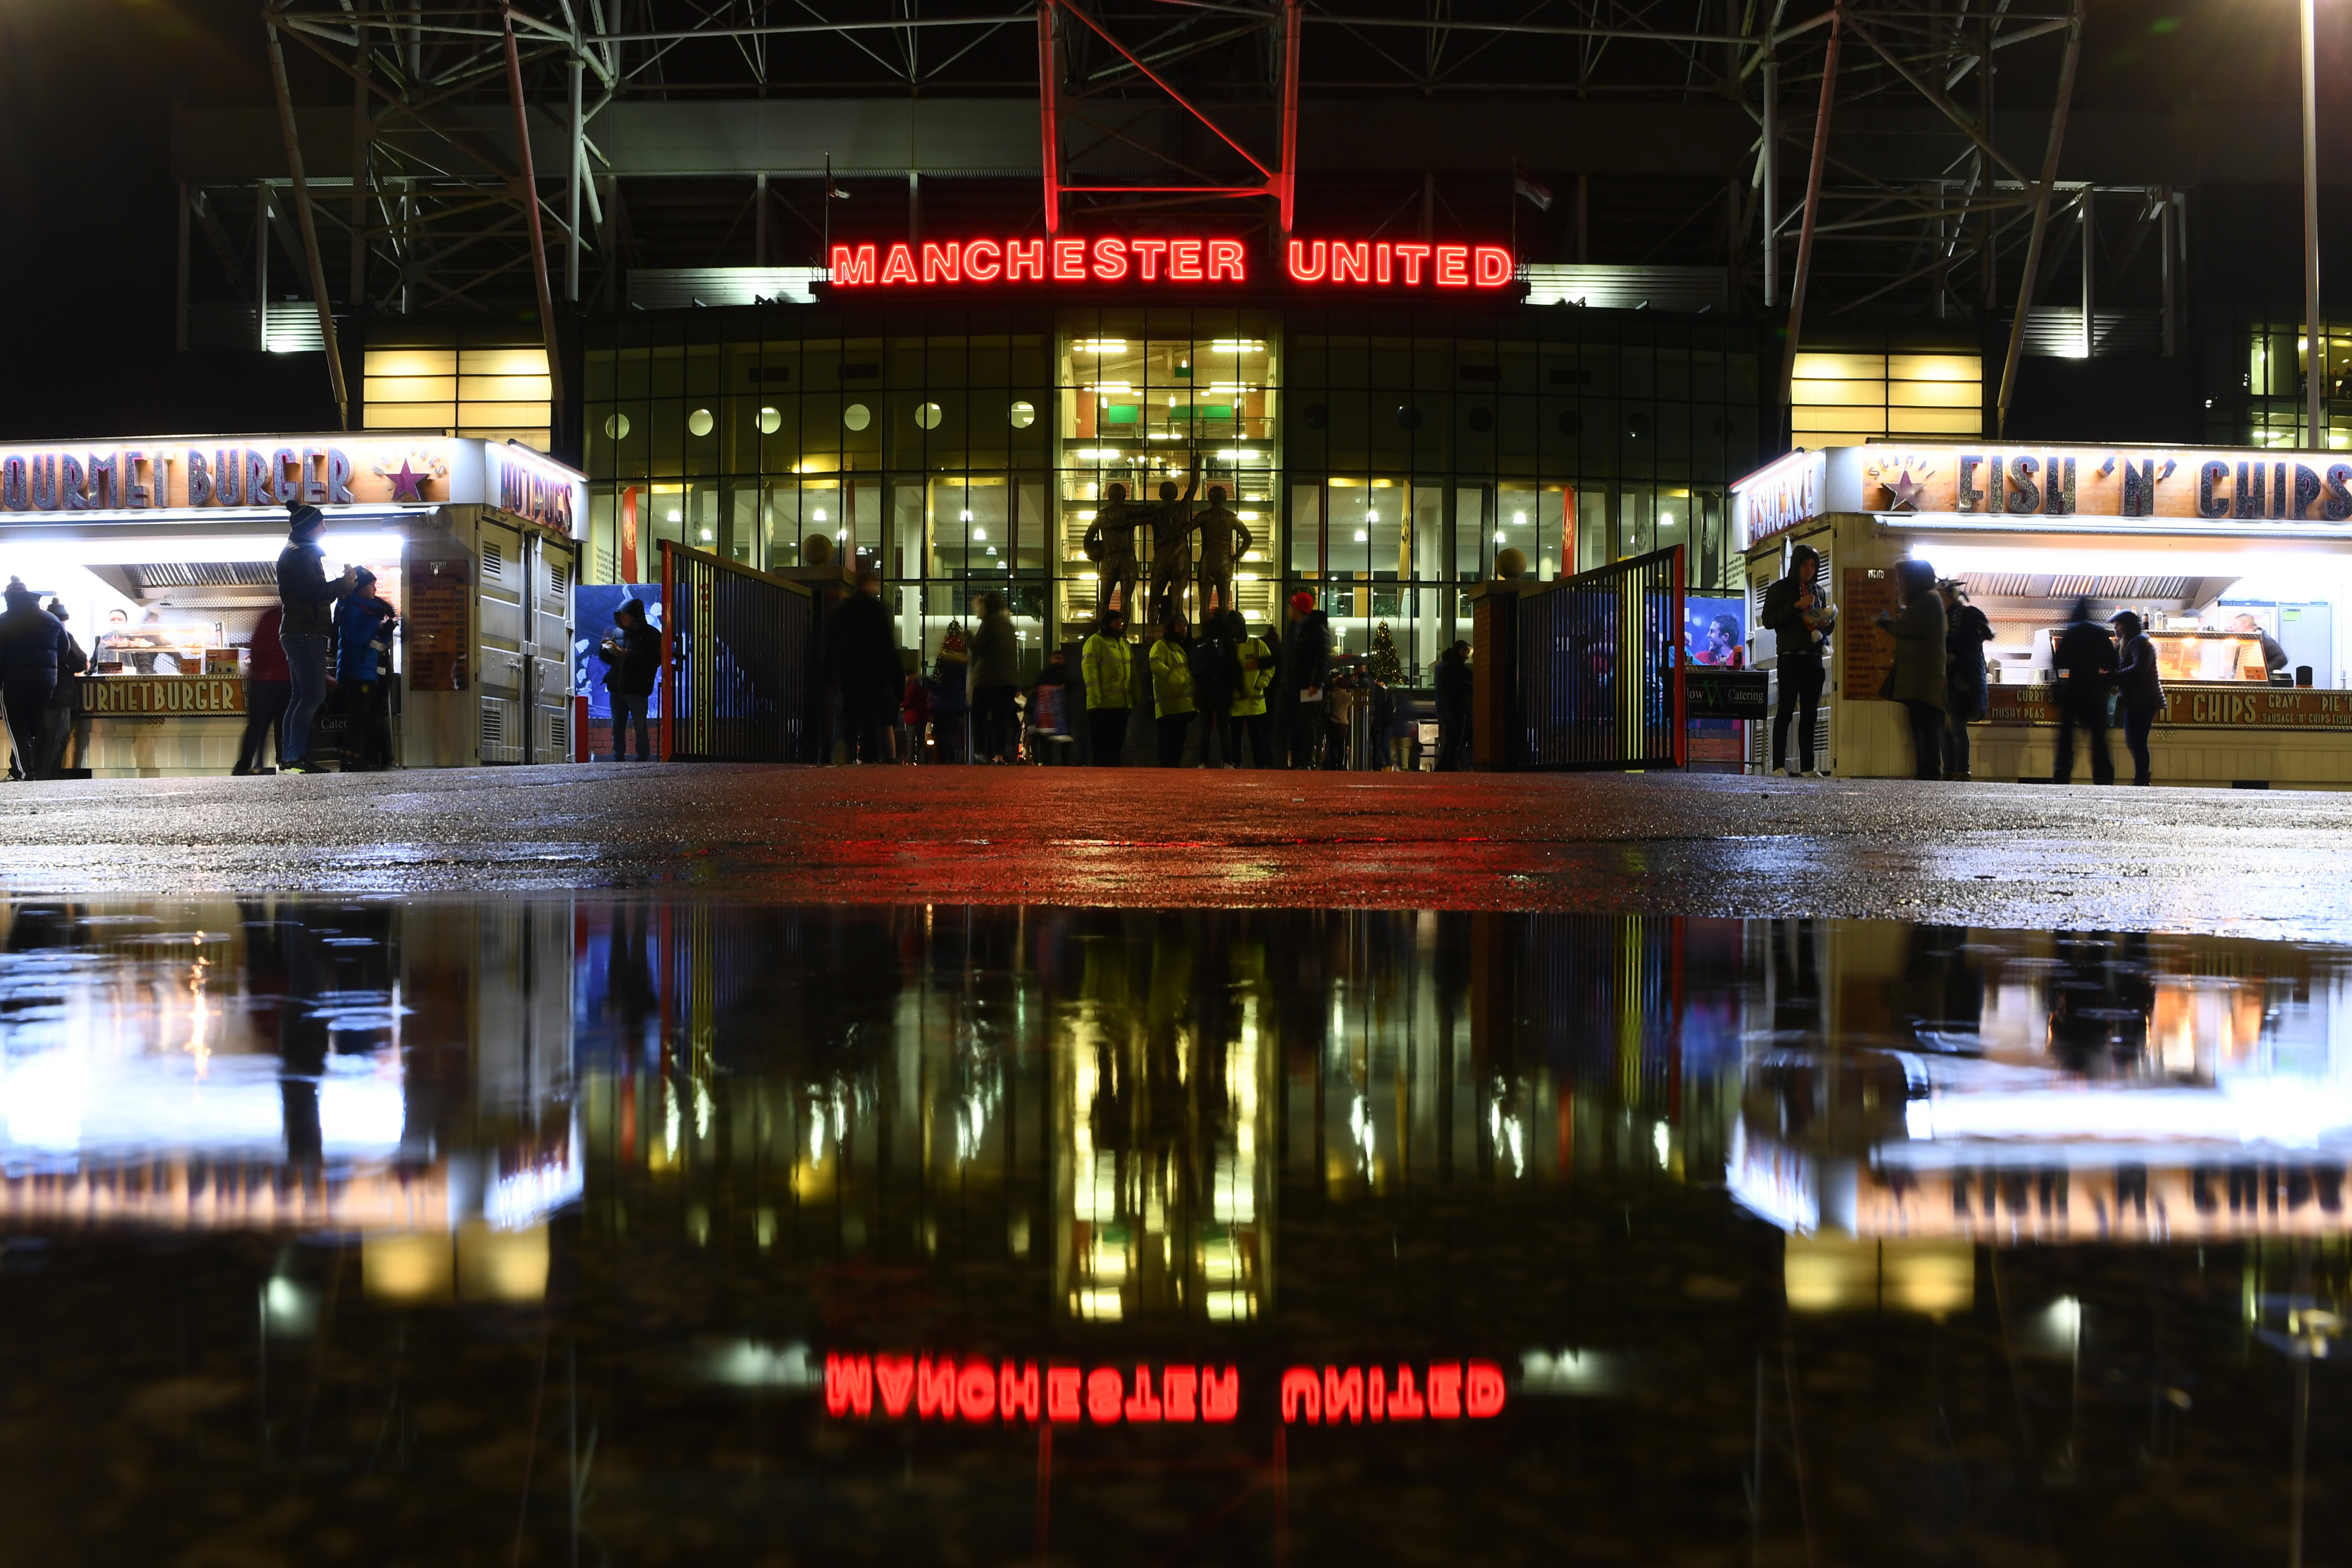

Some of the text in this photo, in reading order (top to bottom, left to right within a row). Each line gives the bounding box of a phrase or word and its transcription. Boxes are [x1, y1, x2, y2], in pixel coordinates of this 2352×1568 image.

[832, 239, 1514, 286] MANCHESTER UNITED
[0, 451, 172, 509] OURMET
[188, 446, 355, 506] BURGER
[1959, 455, 2076, 513] FISH
[2197, 460, 2352, 520] CHIPS
[430, 562, 446, 570] MENU
[1868, 569, 1884, 579] MENU
[74, 681, 234, 711] URMETBURGER
[1728, 688, 1764, 704] Catering
[2016, 690, 2047, 702] CURRY
[2269, 694, 2301, 708] GRAVY
[2193, 694, 2257, 723] CHIPS
[2322, 696, 2339, 711] PIE
[1991, 707, 2045, 719] MUSHY PEAS
[2263, 713, 2294, 723] SAUSAGE
[2309, 714, 2329, 723] CHIPS
[321, 717, 348, 730] Cater
